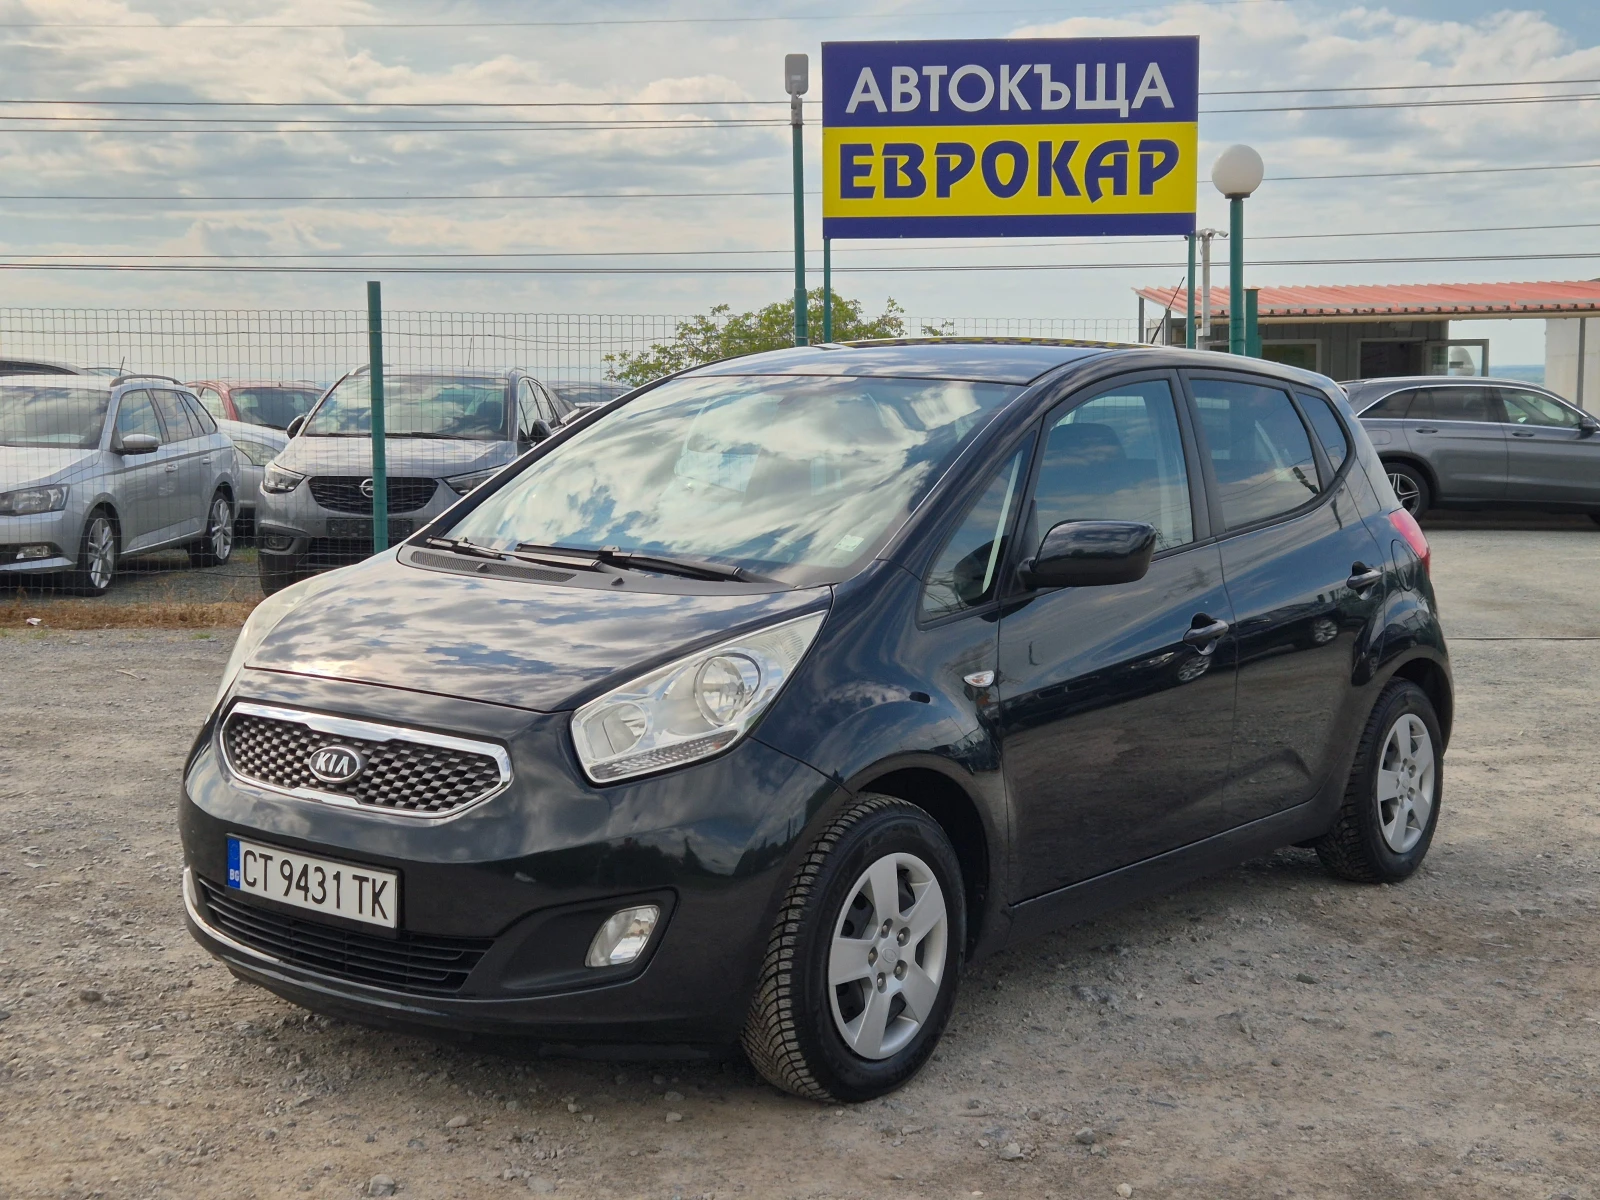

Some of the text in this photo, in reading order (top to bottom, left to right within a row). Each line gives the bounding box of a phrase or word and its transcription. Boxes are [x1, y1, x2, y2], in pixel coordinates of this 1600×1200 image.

[845, 62, 1175, 118] АВТОКЪЩА
[839, 139, 1180, 203] ЕВРОКАР
[315, 752, 349, 775] KIA
[229, 869, 240, 882] BG
[243, 849, 389, 920] CT 9431 TK
